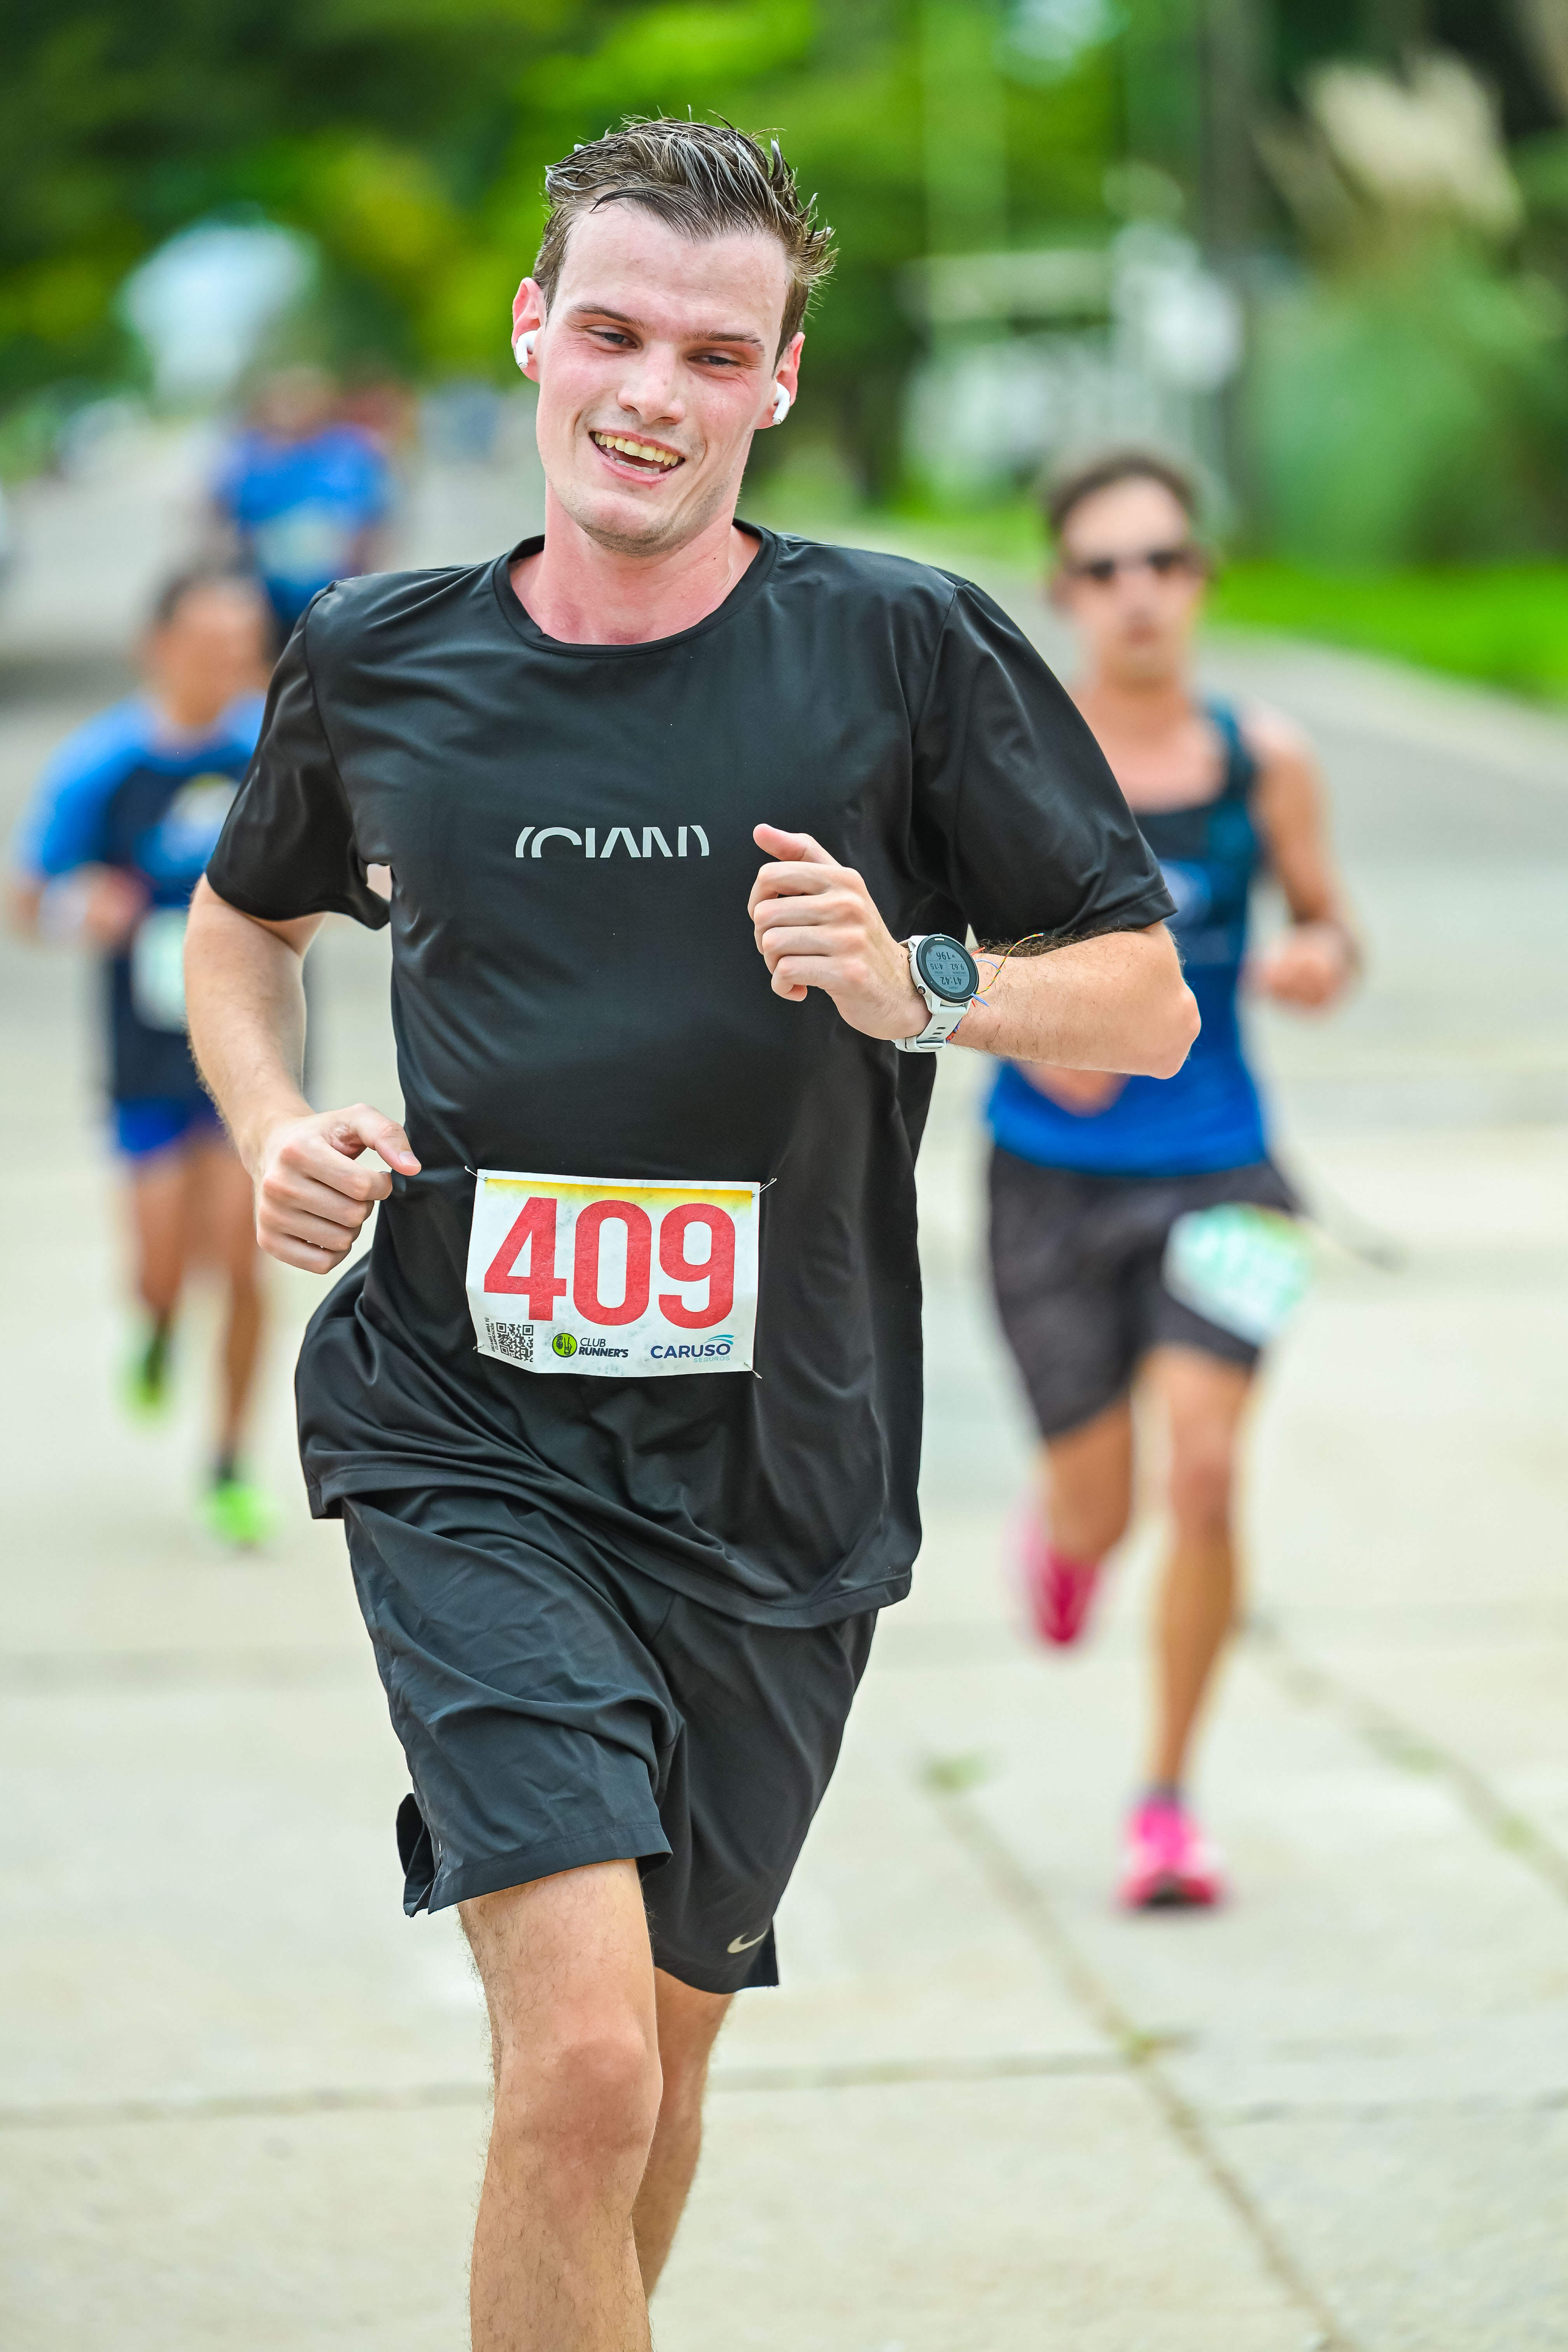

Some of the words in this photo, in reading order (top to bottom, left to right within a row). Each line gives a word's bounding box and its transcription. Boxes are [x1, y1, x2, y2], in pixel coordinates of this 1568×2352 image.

[936, 952, 951, 960] 196
[940, 976, 962, 985] 41:42
[483, 1196, 736, 1330] 409
[580, 1337, 606, 1347] CLUB
[578, 1347, 629, 1358] RUNNER'S
[650, 1343, 731, 1359] CARUSO
